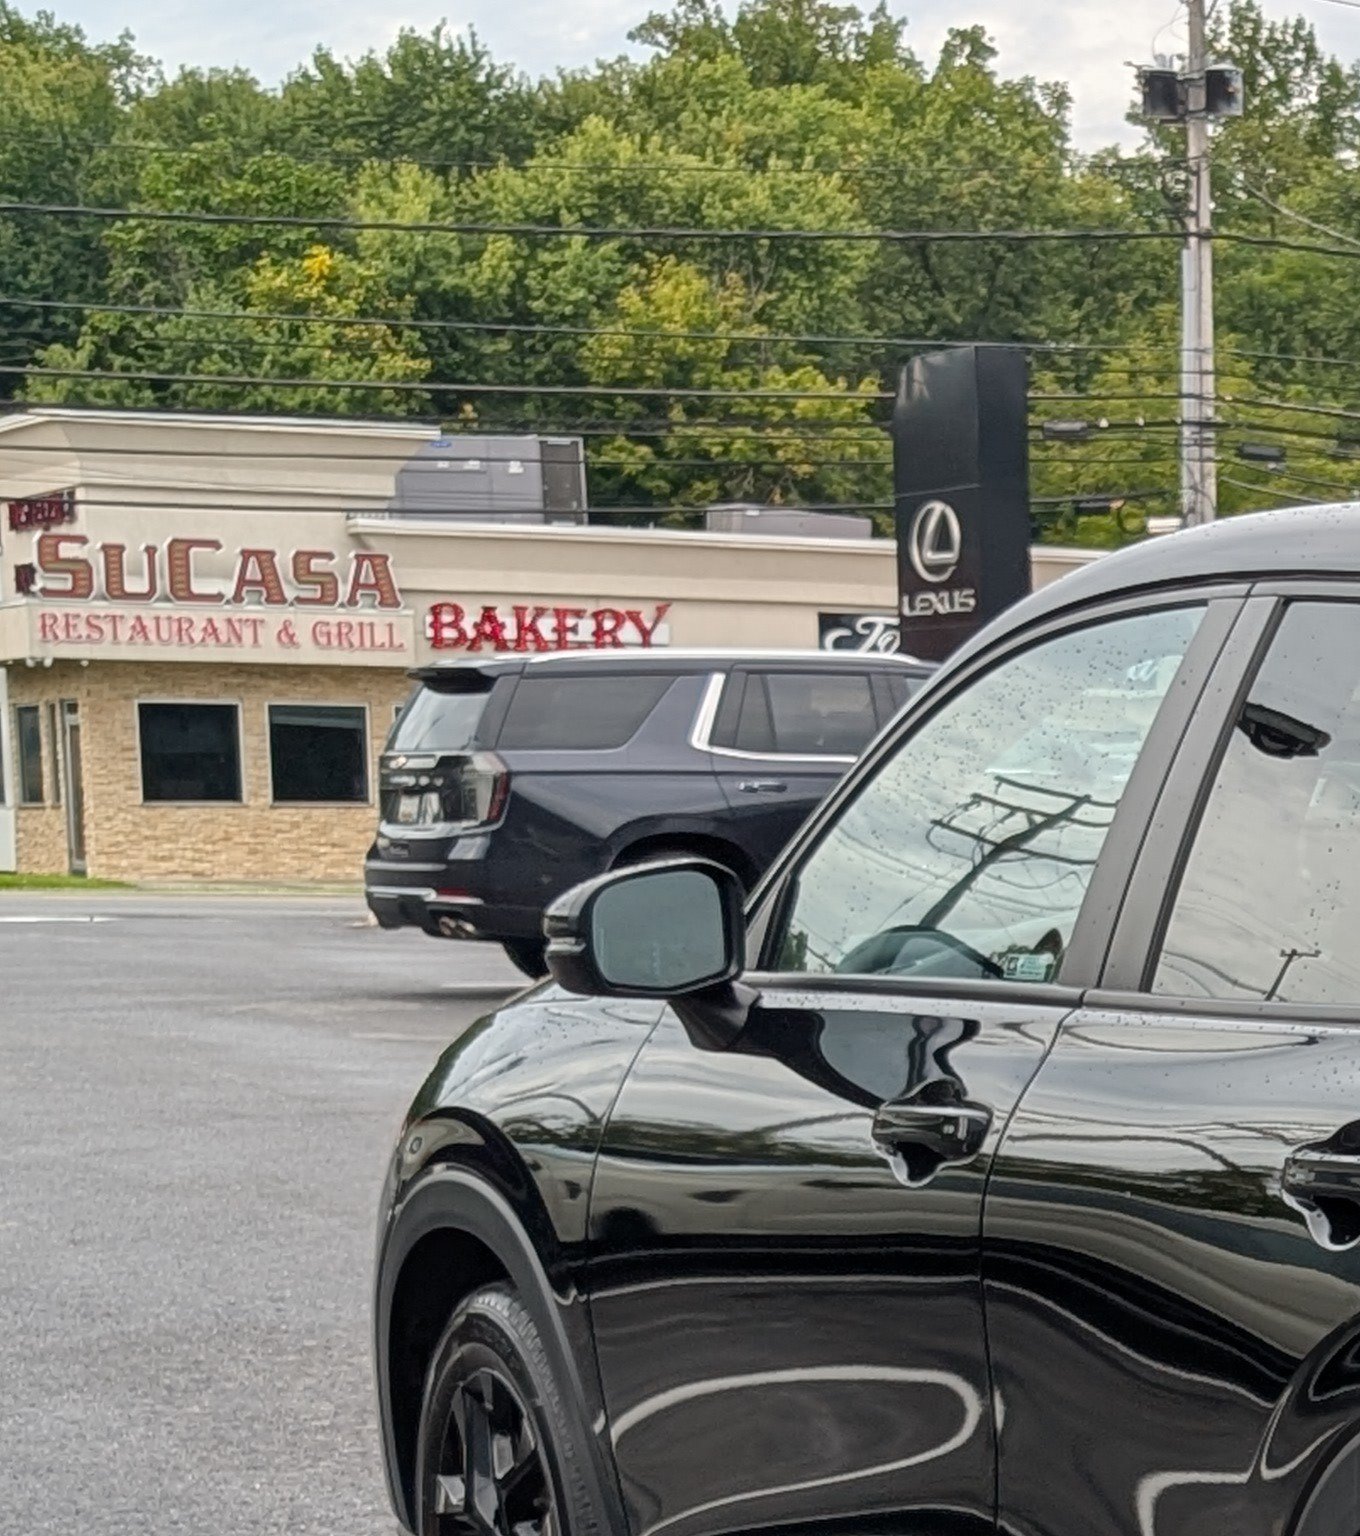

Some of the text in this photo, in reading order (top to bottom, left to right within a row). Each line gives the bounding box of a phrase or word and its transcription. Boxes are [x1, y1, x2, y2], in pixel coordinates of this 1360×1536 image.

[902, 588, 977, 617] LEXUS
[39, 612, 405, 652] RESTAURANT & GRILL
[428, 602, 671, 652] BAKERY
